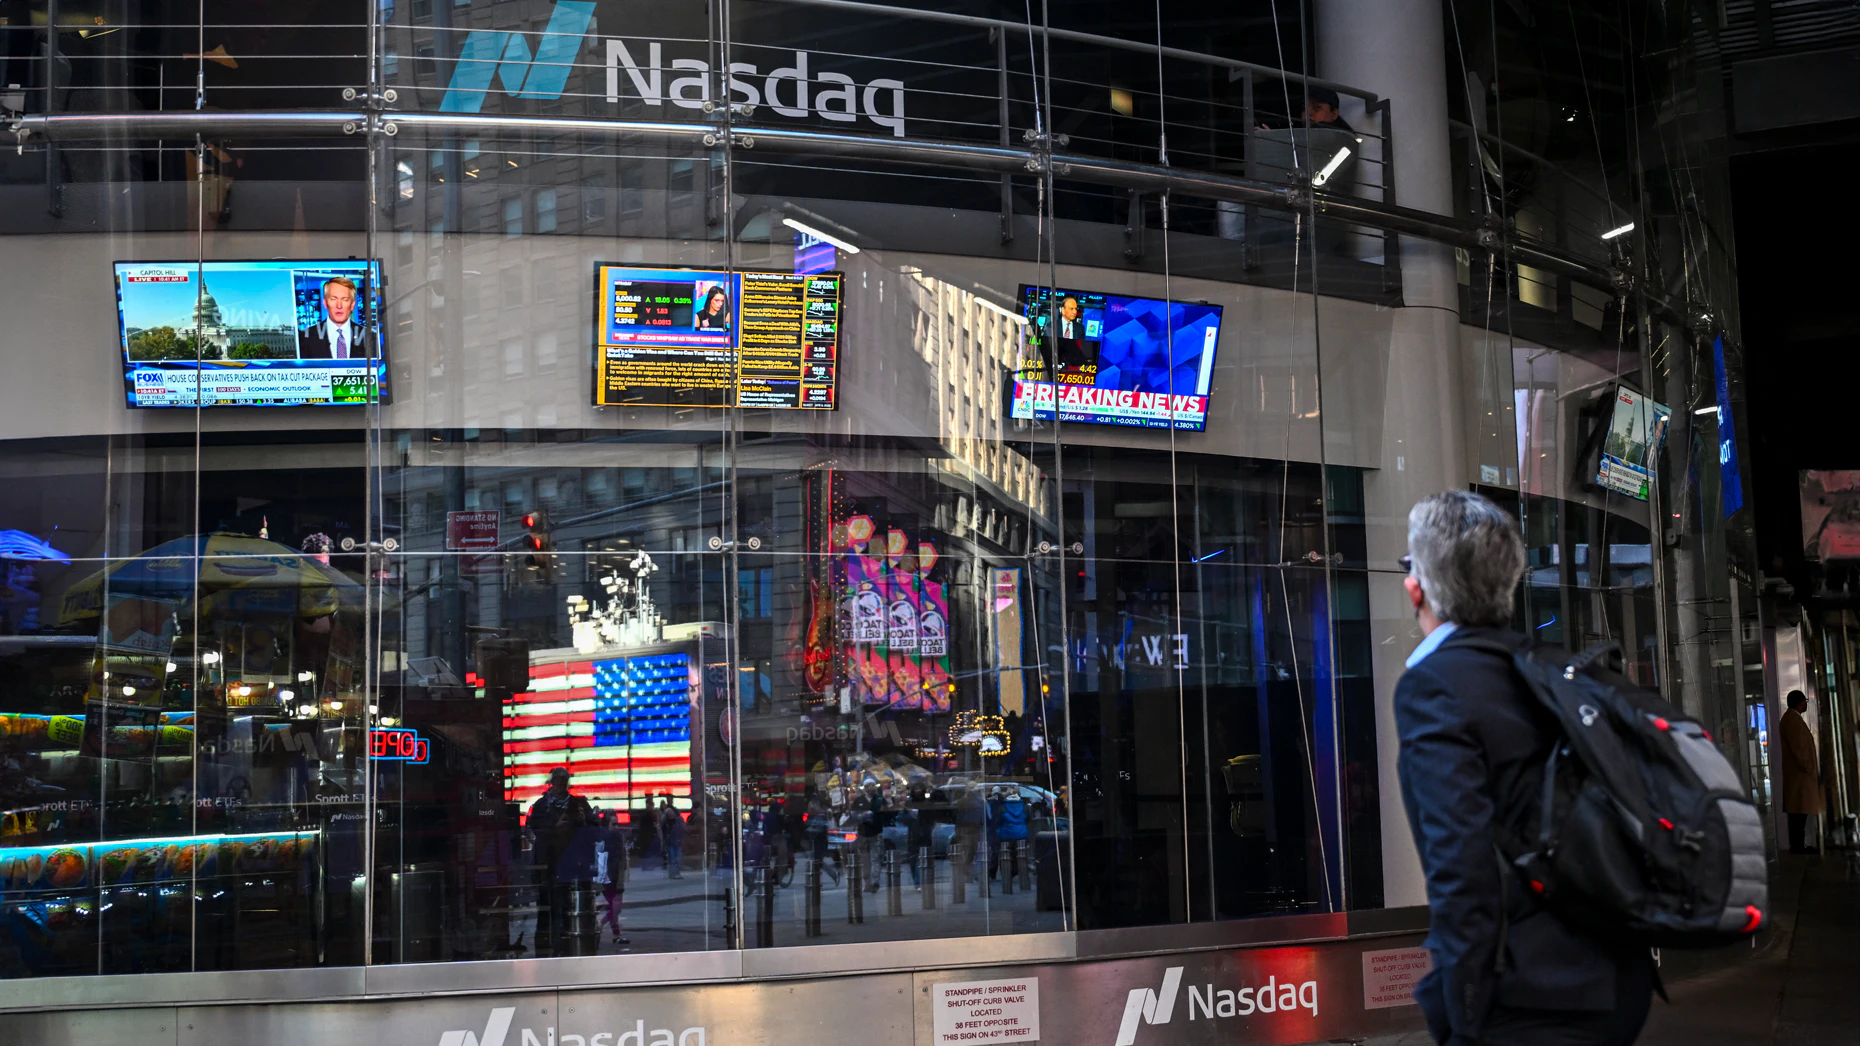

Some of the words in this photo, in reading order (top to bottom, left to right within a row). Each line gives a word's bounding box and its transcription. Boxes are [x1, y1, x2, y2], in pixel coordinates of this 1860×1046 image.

[606, 40, 904, 138] Nasdaq
[1079, 365, 1097, 373] 4.42
[136, 373, 158, 382] FOX
[167, 374, 187, 383] HOUSE
[188, 374, 233, 382] COSERVATIVES
[235, 374, 250, 382] PUSH
[251, 373, 266, 382] BACK
[267, 373, 276, 381] ON
[278, 373, 288, 381] TAX
[302, 373, 328, 381] PACKAGE
[1022, 383, 1133, 407] BREAKING
[1138, 392, 1200, 412] NEWS
[315, 794, 349, 804] Sprott
[1371, 955, 1397, 963] STANDPIPE
[1401, 952, 1427, 960] SPRINKLER
[1373, 965, 1396, 973] SHUT-OFF
[945, 988, 983, 997] STANDPIPE
[988, 985, 1026, 994] SPRINKLER
[1189, 975, 1317, 1020] Nasdaq
[948, 999, 982, 1007] SHUT-OFF
[971, 1008, 1002, 1017] LOCATED
[984, 1018, 1018, 1027] OPPOSITE
[1004, 1028, 1031, 1036] STREET
